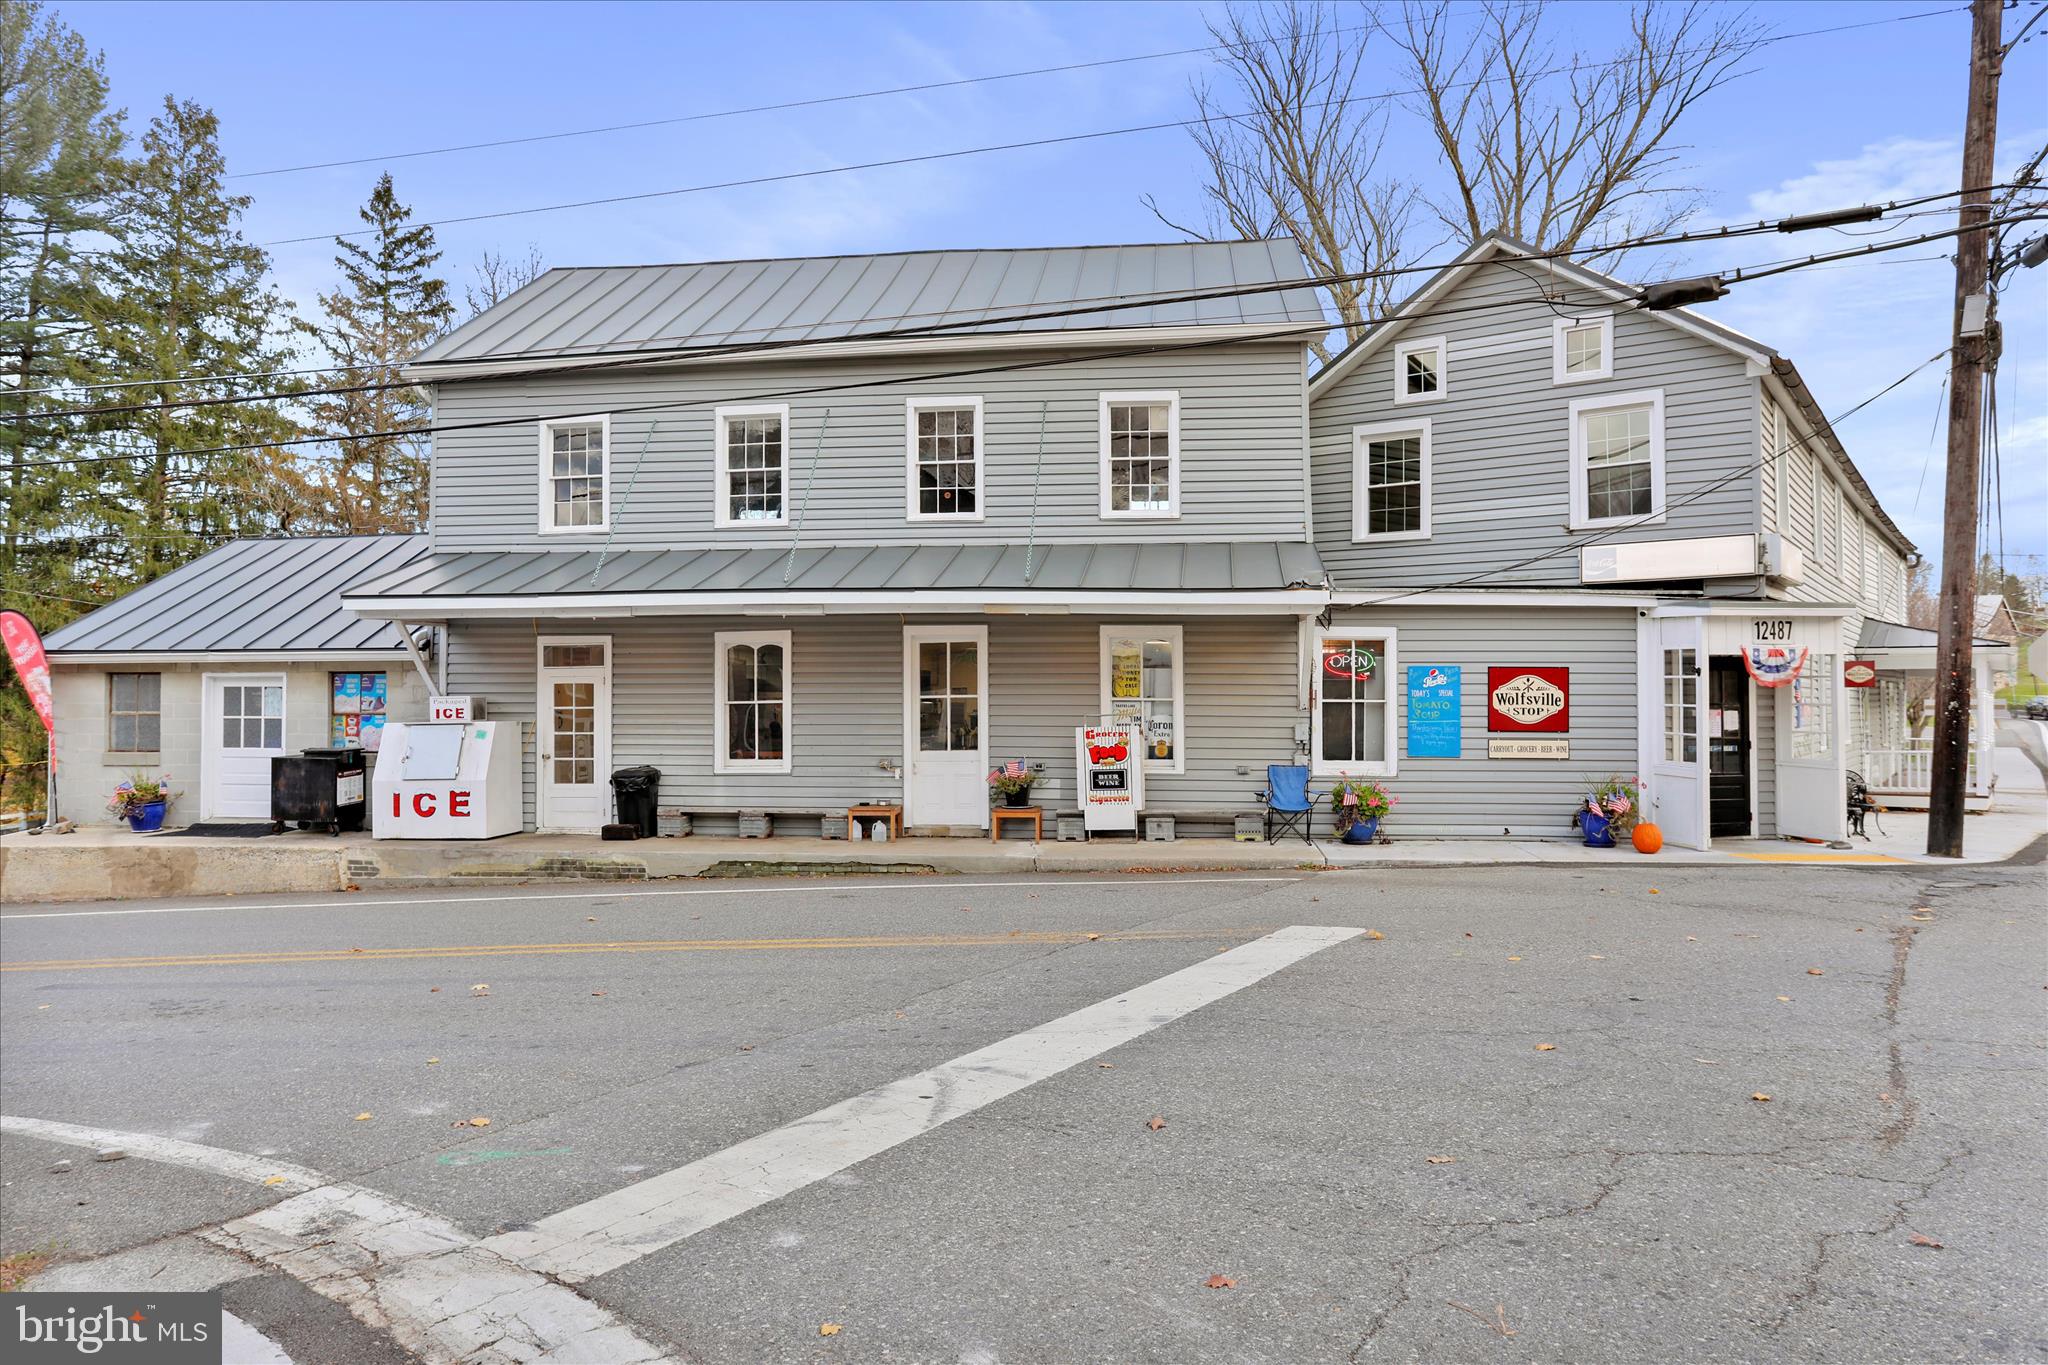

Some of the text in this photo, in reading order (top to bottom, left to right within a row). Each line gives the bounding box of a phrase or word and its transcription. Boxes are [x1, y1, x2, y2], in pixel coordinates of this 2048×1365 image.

[1754, 620, 1793, 640] 12487
[1331, 655, 1368, 668] OPEN
[1411, 688, 1454, 698] TODAY'S SPECIAL
[1495, 691, 1562, 707] Wolfsville
[435, 707, 465, 719] ICE
[1512, 707, 1545, 716] STOP
[1129, 715, 1142, 723] TIM
[1148, 720, 1173, 733] Coron
[1153, 729, 1170, 738] Extra
[1490, 744, 1567, 753] CARRYOUT GROCERY BEER WINE
[392, 790, 471, 818] ICE
